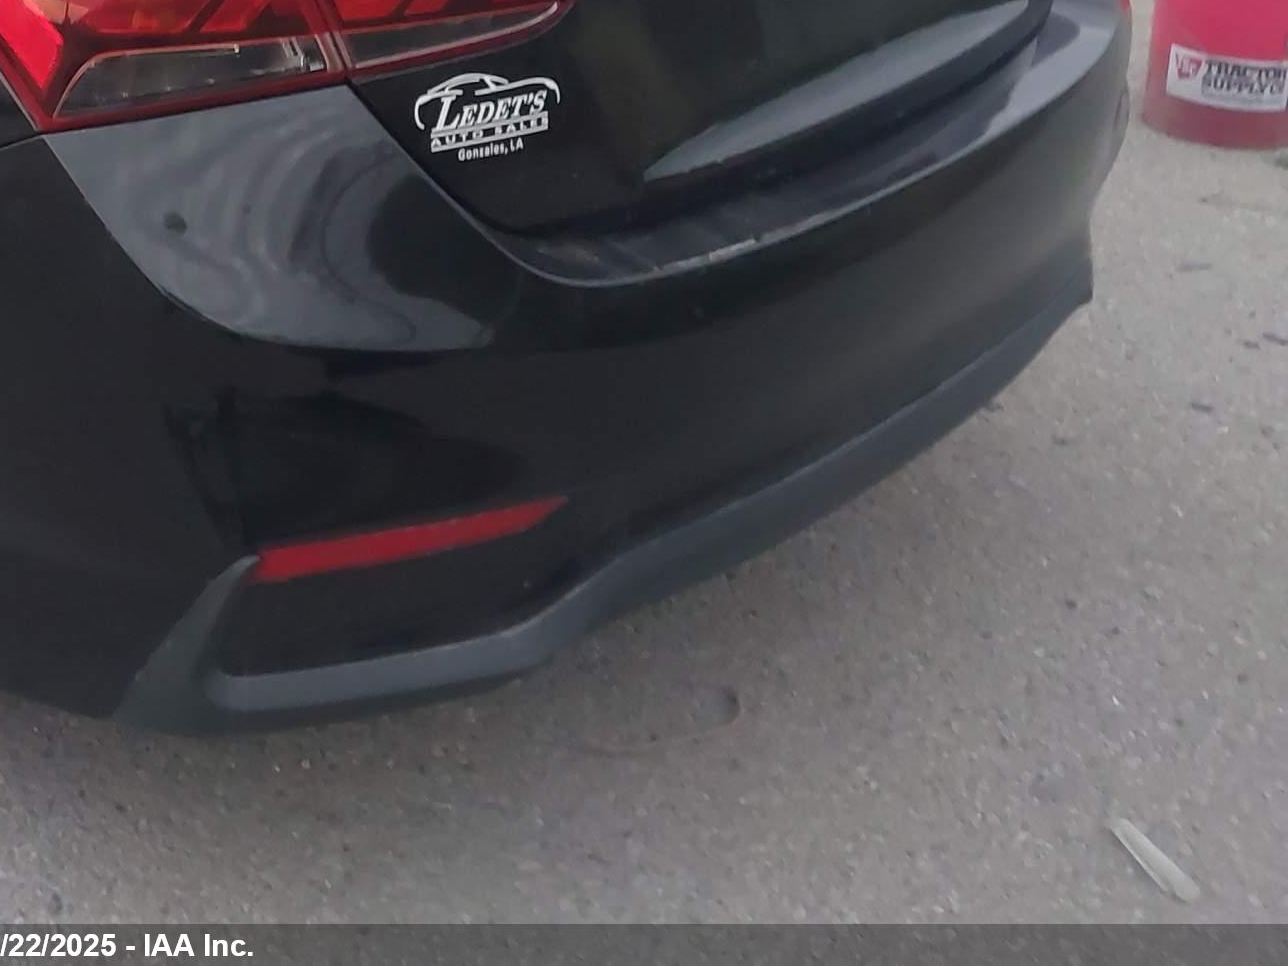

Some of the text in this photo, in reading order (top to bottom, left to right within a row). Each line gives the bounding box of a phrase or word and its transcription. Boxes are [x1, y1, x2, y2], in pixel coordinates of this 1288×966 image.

[433, 89, 548, 131] LEDET'S
[431, 130, 484, 149] AUTO
[510, 137, 524, 150] LA
